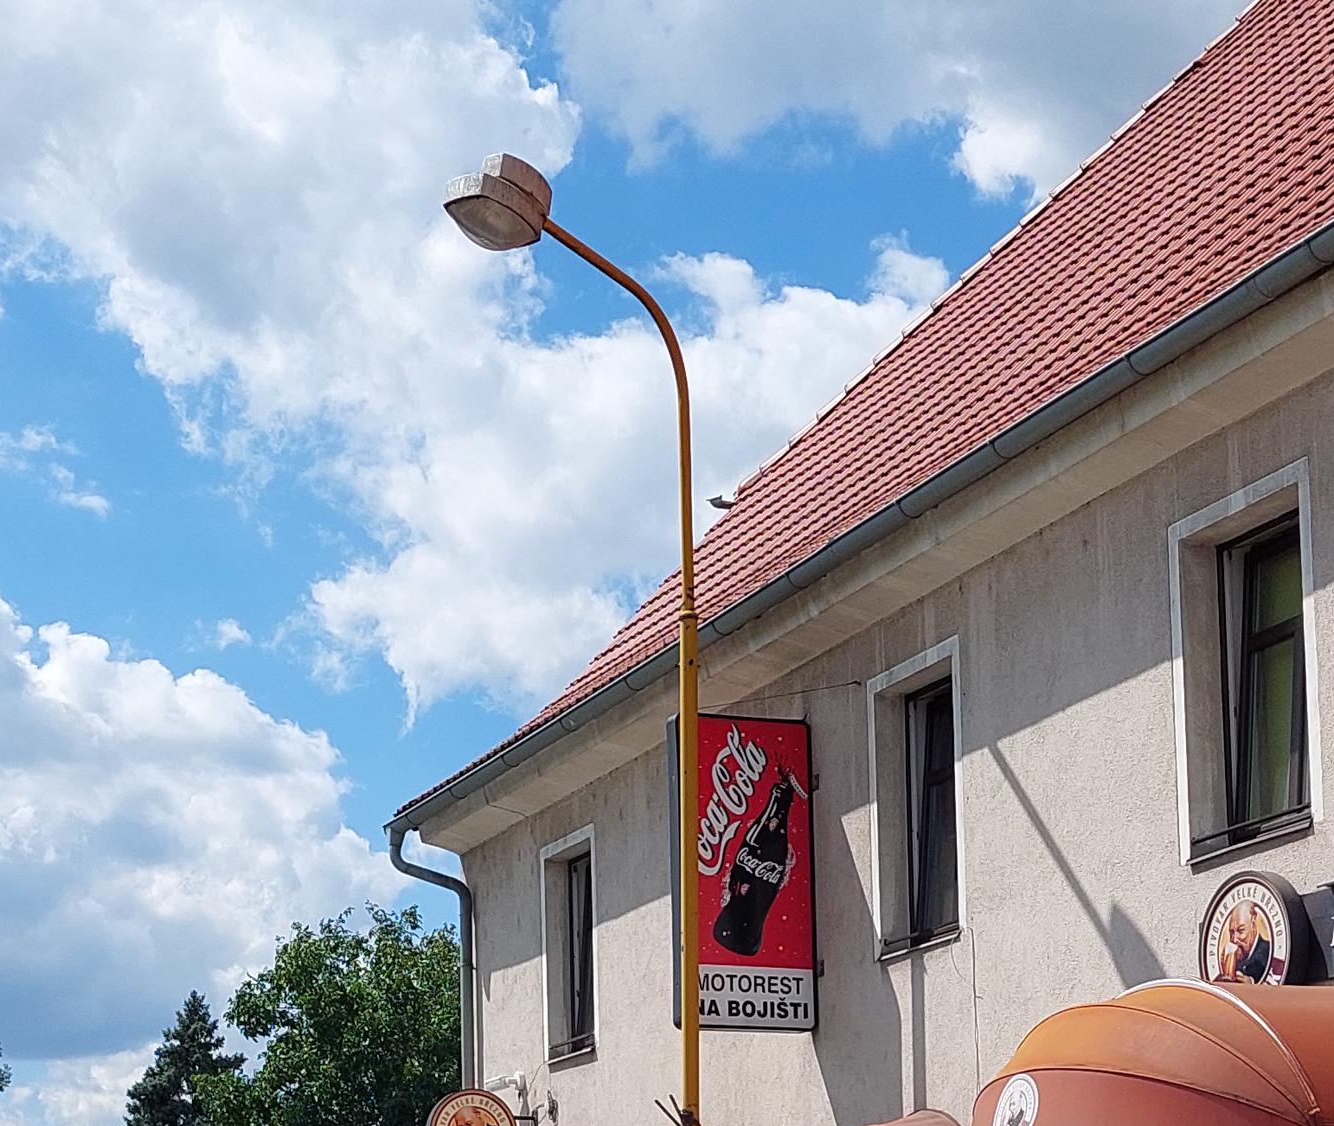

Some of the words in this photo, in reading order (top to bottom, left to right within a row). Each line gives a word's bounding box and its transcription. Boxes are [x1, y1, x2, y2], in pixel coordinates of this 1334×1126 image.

[1209, 903, 1230, 957] PIVOVAR
[1231, 885, 1258, 903] VELKÉ
[699, 973, 804, 996] MOTOREST
[728, 997, 809, 1020] BOJIŠTI
